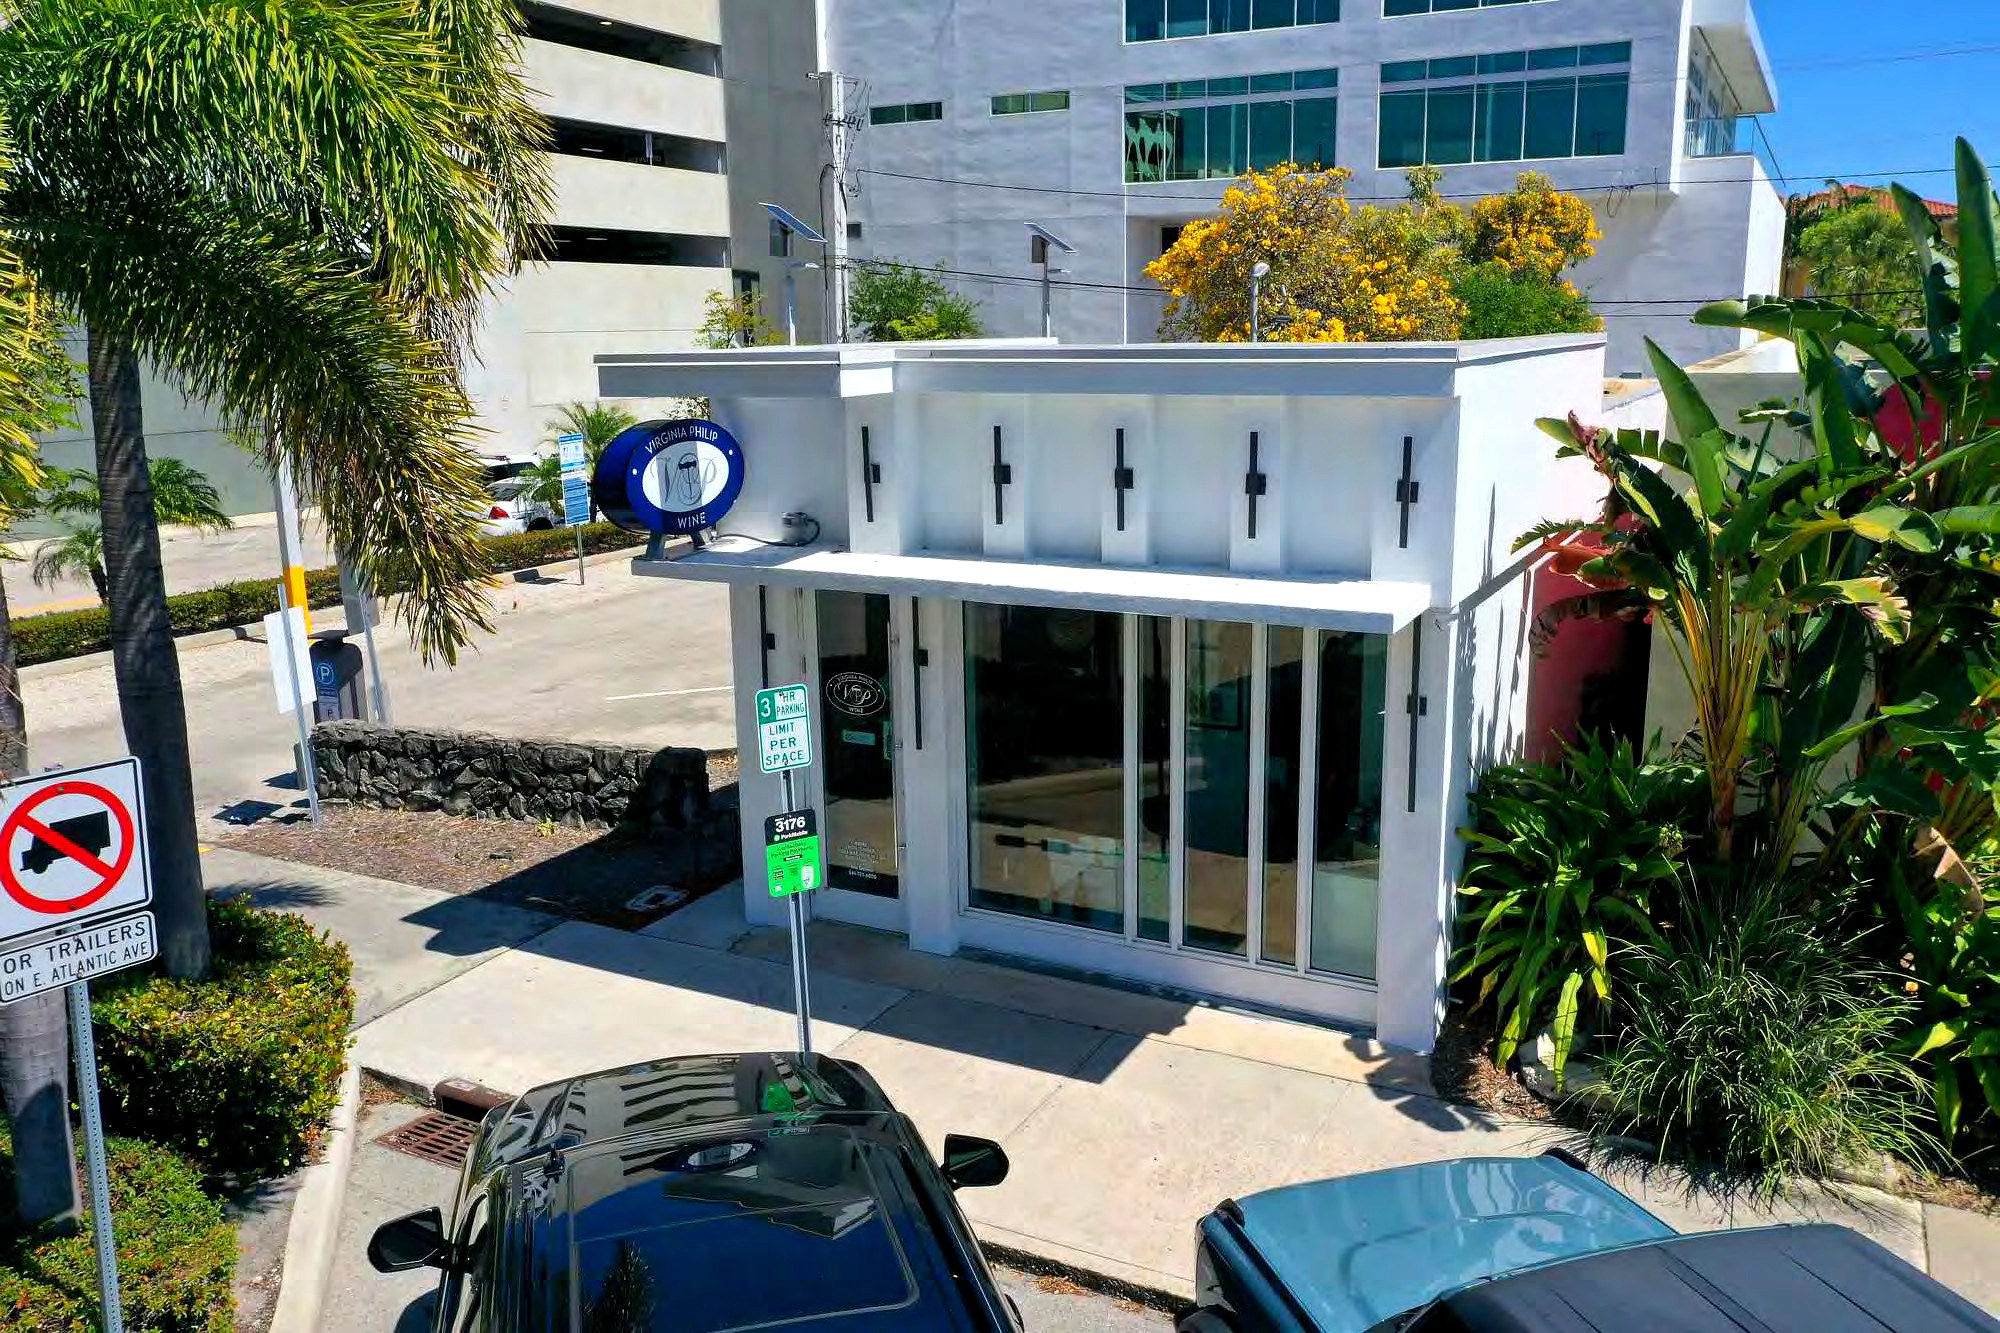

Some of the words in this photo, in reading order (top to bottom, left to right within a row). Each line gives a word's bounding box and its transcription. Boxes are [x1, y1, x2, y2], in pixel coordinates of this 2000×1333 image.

[645, 427, 688, 454] VIRGINIA
[689, 426, 718, 442] PHILIP
[677, 512, 707, 529] WINE
[320, 666, 330, 681] P
[783, 691, 796, 702] HR
[760, 697, 771, 718] 3
[776, 702, 805, 716] PARKING
[769, 722, 795, 736] LIMIT
[770, 736, 797, 751] PER
[766, 750, 805, 766] SPACE
[775, 816, 806, 833] 3176
[4, 953, 32, 975] OR
[46, 921, 146, 962] TRAILERS
[4, 977, 25, 997] ON
[34, 973, 46, 988] E.
[51, 950, 117, 983] ATLANTIC
[123, 941, 148, 962] AVE
